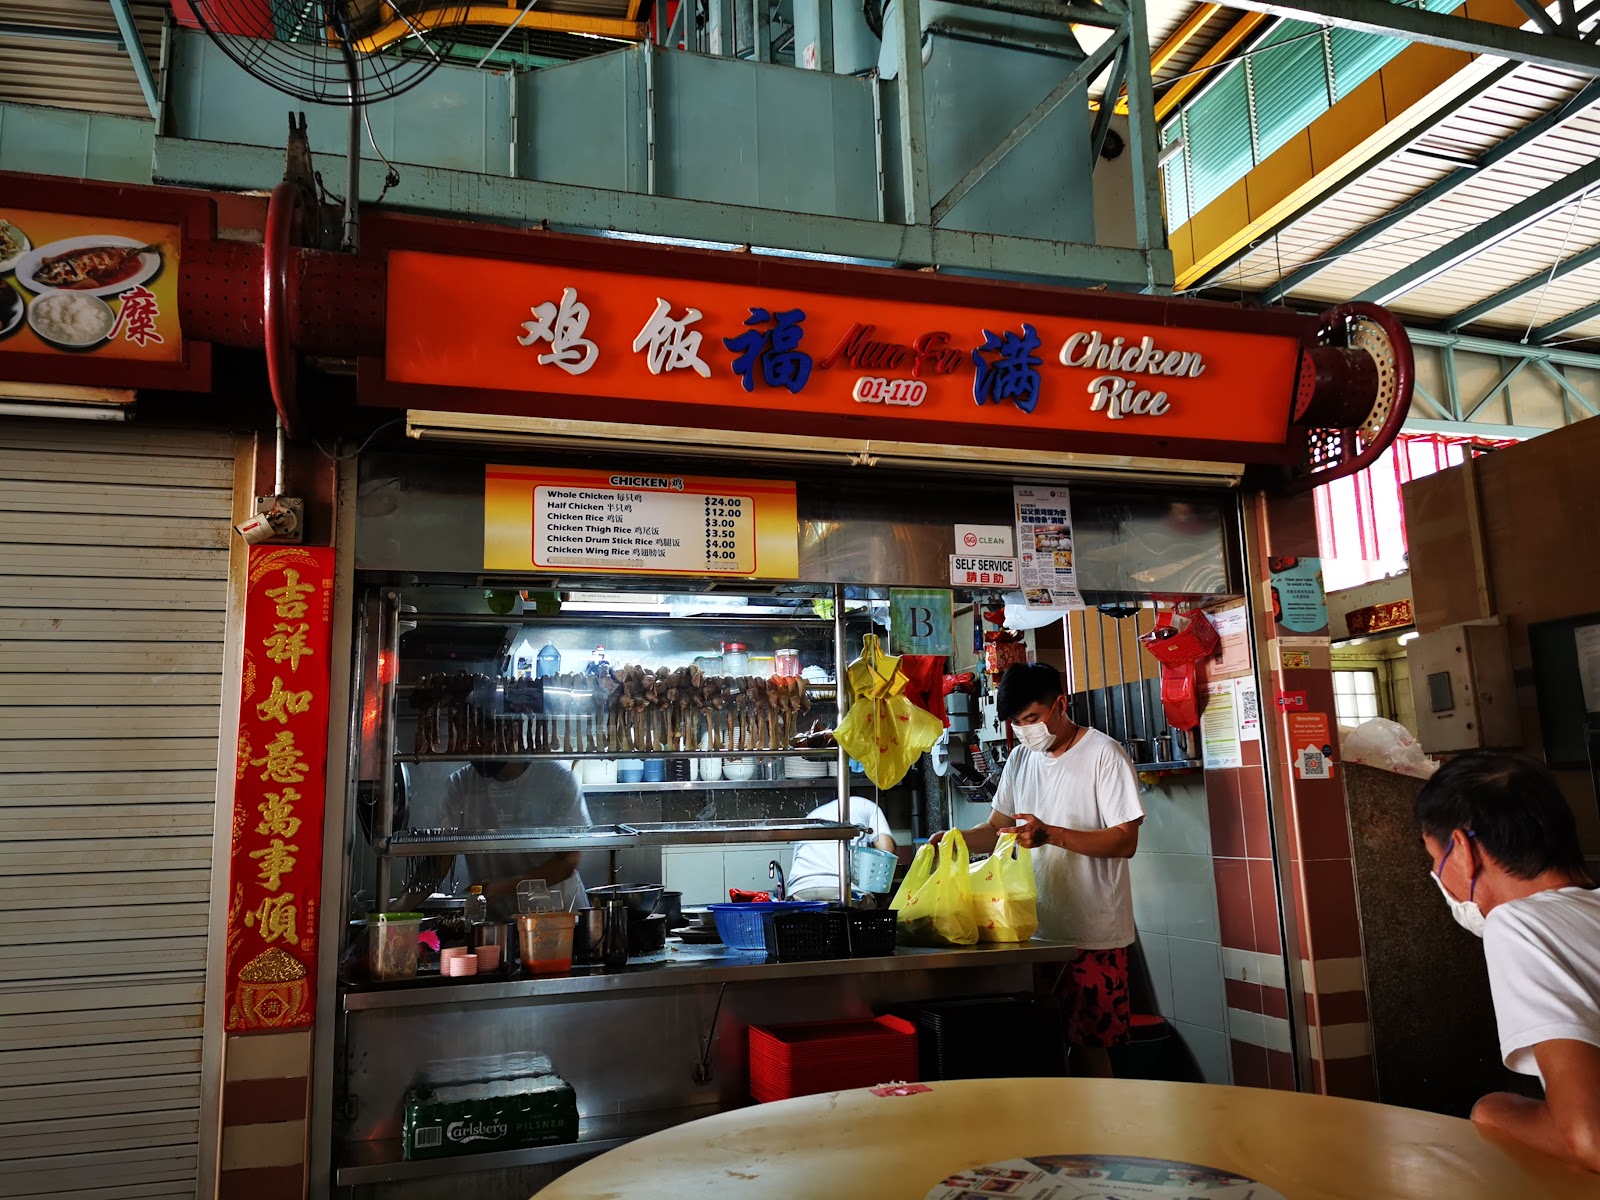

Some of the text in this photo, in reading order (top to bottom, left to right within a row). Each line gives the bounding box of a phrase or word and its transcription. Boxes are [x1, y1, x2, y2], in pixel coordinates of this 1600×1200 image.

[517, 286, 711, 378] 鸡饭
[722, 307, 813, 394] 福
[1059, 330, 1206, 378] Chicken
[971, 323, 1044, 414] 满
[858, 378, 925, 404] 01-110
[1087, 375, 1170, 420] Rice
[610, 476, 683, 490] CHICKEN 鸡
[547, 490, 577, 498] Whole
[579, 492, 614, 501] Chicken
[704, 496, 741, 507] $24.00
[547, 502, 566, 510] Half
[568, 502, 604, 511] Chicken
[704, 507, 741, 517] $12.00
[547, 512, 583, 521] Chicken
[585, 514, 604, 522] Rice
[705, 518, 735, 528] $3.00
[547, 524, 583, 532] Chicken
[585, 525, 611, 535] Thigh
[614, 526, 632, 534] Rice
[705, 528, 735, 538] $3.50
[547, 535, 583, 543] Chicken
[585, 536, 610, 544] Drum
[612, 537, 633, 545] Stick
[634, 538, 653, 546] Rice
[706, 538, 735, 549] $4.00
[979, 537, 1004, 545] CLEAN
[547, 546, 583, 554] Chicken
[585, 547, 609, 556] Wing
[612, 548, 630, 556] Rice
[706, 550, 736, 560] $4.00
[955, 558, 977, 570] SELF
[978, 559, 1014, 572] SERVICE
[966, 571, 1004, 584] 請自助
[909, 607, 934, 638] B
[447, 1119, 508, 1143] Carlsberg
[516, 1119, 565, 1131] PILSNER
